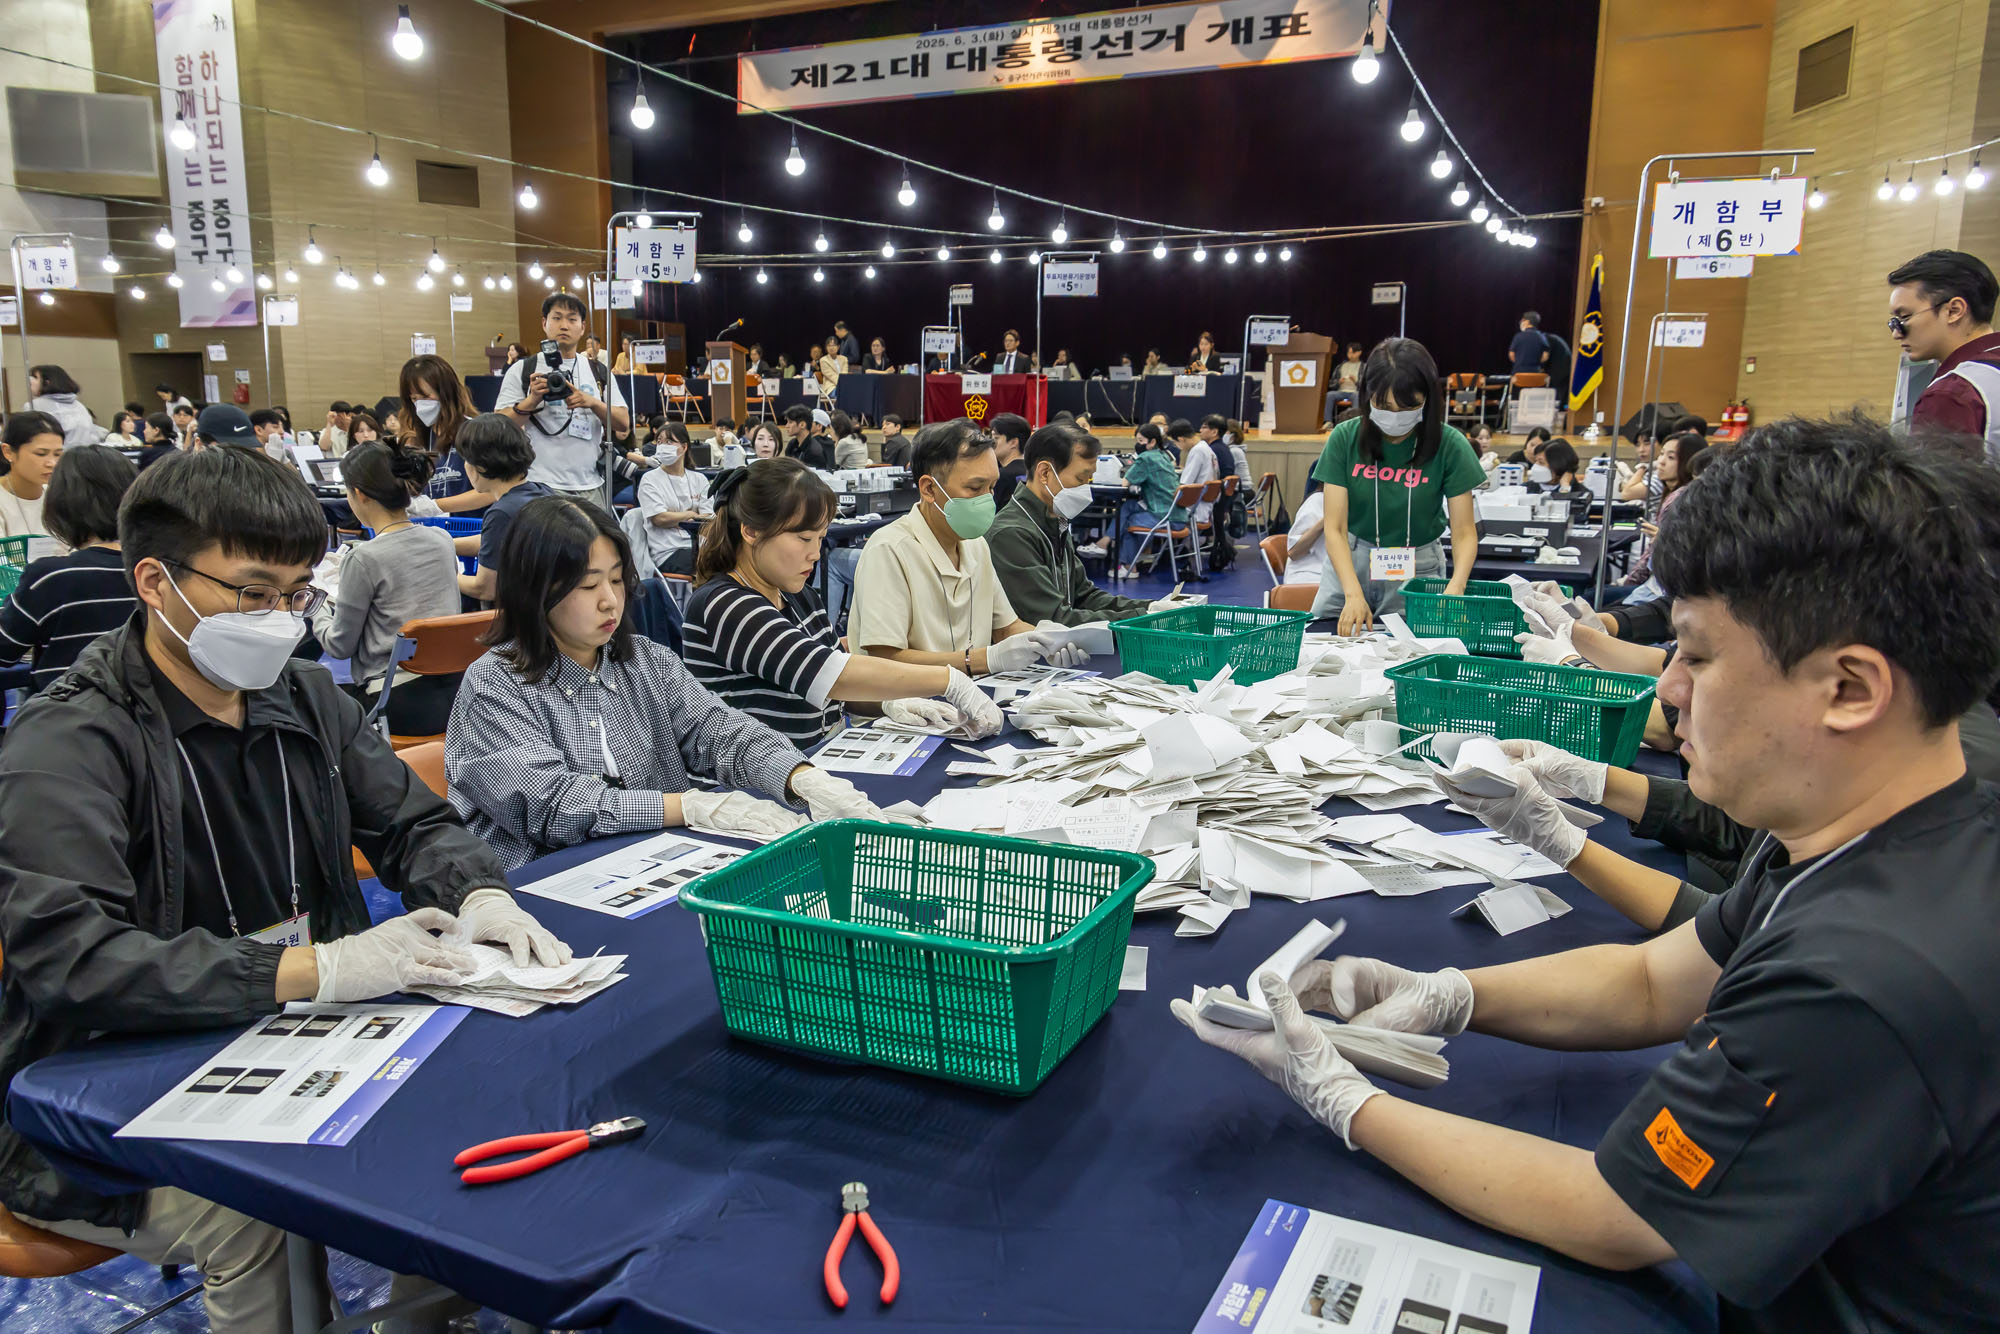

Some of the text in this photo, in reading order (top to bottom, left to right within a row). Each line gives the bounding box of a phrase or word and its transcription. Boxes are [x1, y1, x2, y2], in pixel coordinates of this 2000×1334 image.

[790, 11, 1312, 88] 제21대 대통령선거 개표
[916, 38, 946, 49] 2025.
[954, 36, 965, 46] 6.
[1041, 21, 1081, 35] 제21대
[1087, 13, 1153, 31] 대통령선거
[174, 54, 209, 264] 함께는 중구
[199, 49, 234, 263] 하나되는 중구
[1352, 463, 1429, 488] reorg.
